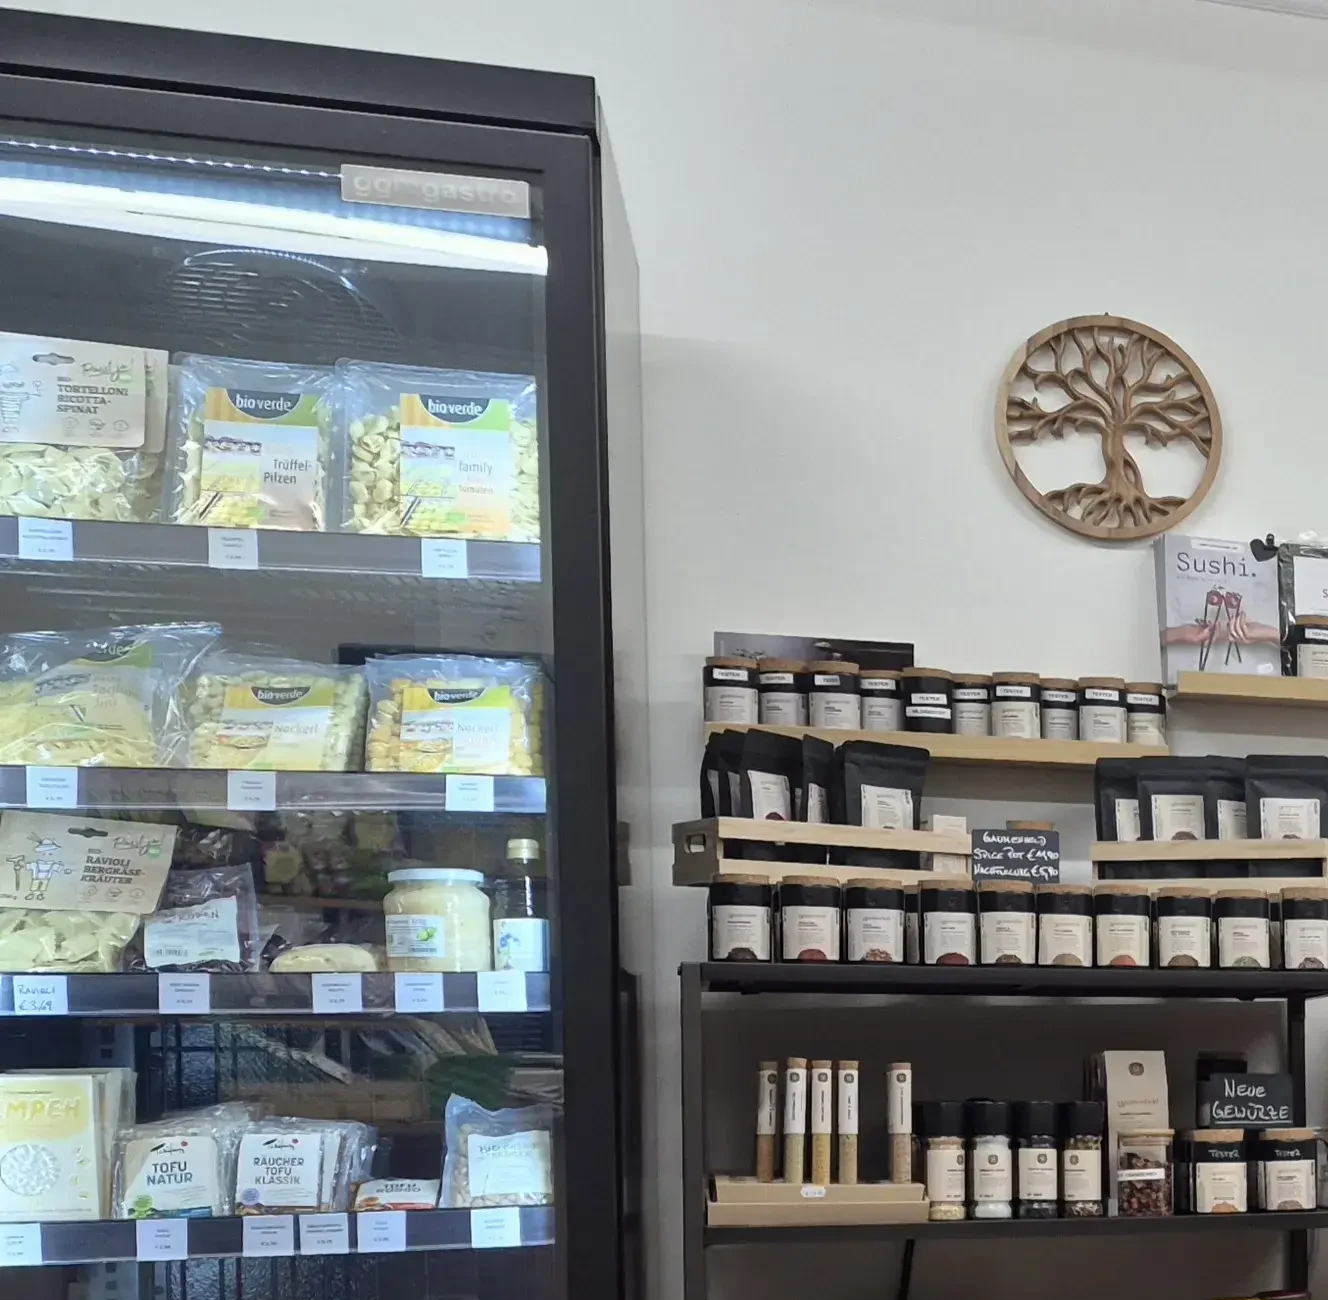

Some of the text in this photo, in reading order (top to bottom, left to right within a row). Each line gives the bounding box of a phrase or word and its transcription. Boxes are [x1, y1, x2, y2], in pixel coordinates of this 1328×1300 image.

[263, 471, 297, 486] Pilzen
[1176, 551, 1257, 578] Sushi.
[86, 856, 132, 868] RAVIOLI
[152, 1160, 187, 1175] TOFU
[253, 1153, 305, 1168] RÄUCHER
[264, 1165, 292, 1177] TOFU
[146, 1172, 193, 1187] NATUR
[254, 1174, 301, 1187] KLASSIK
